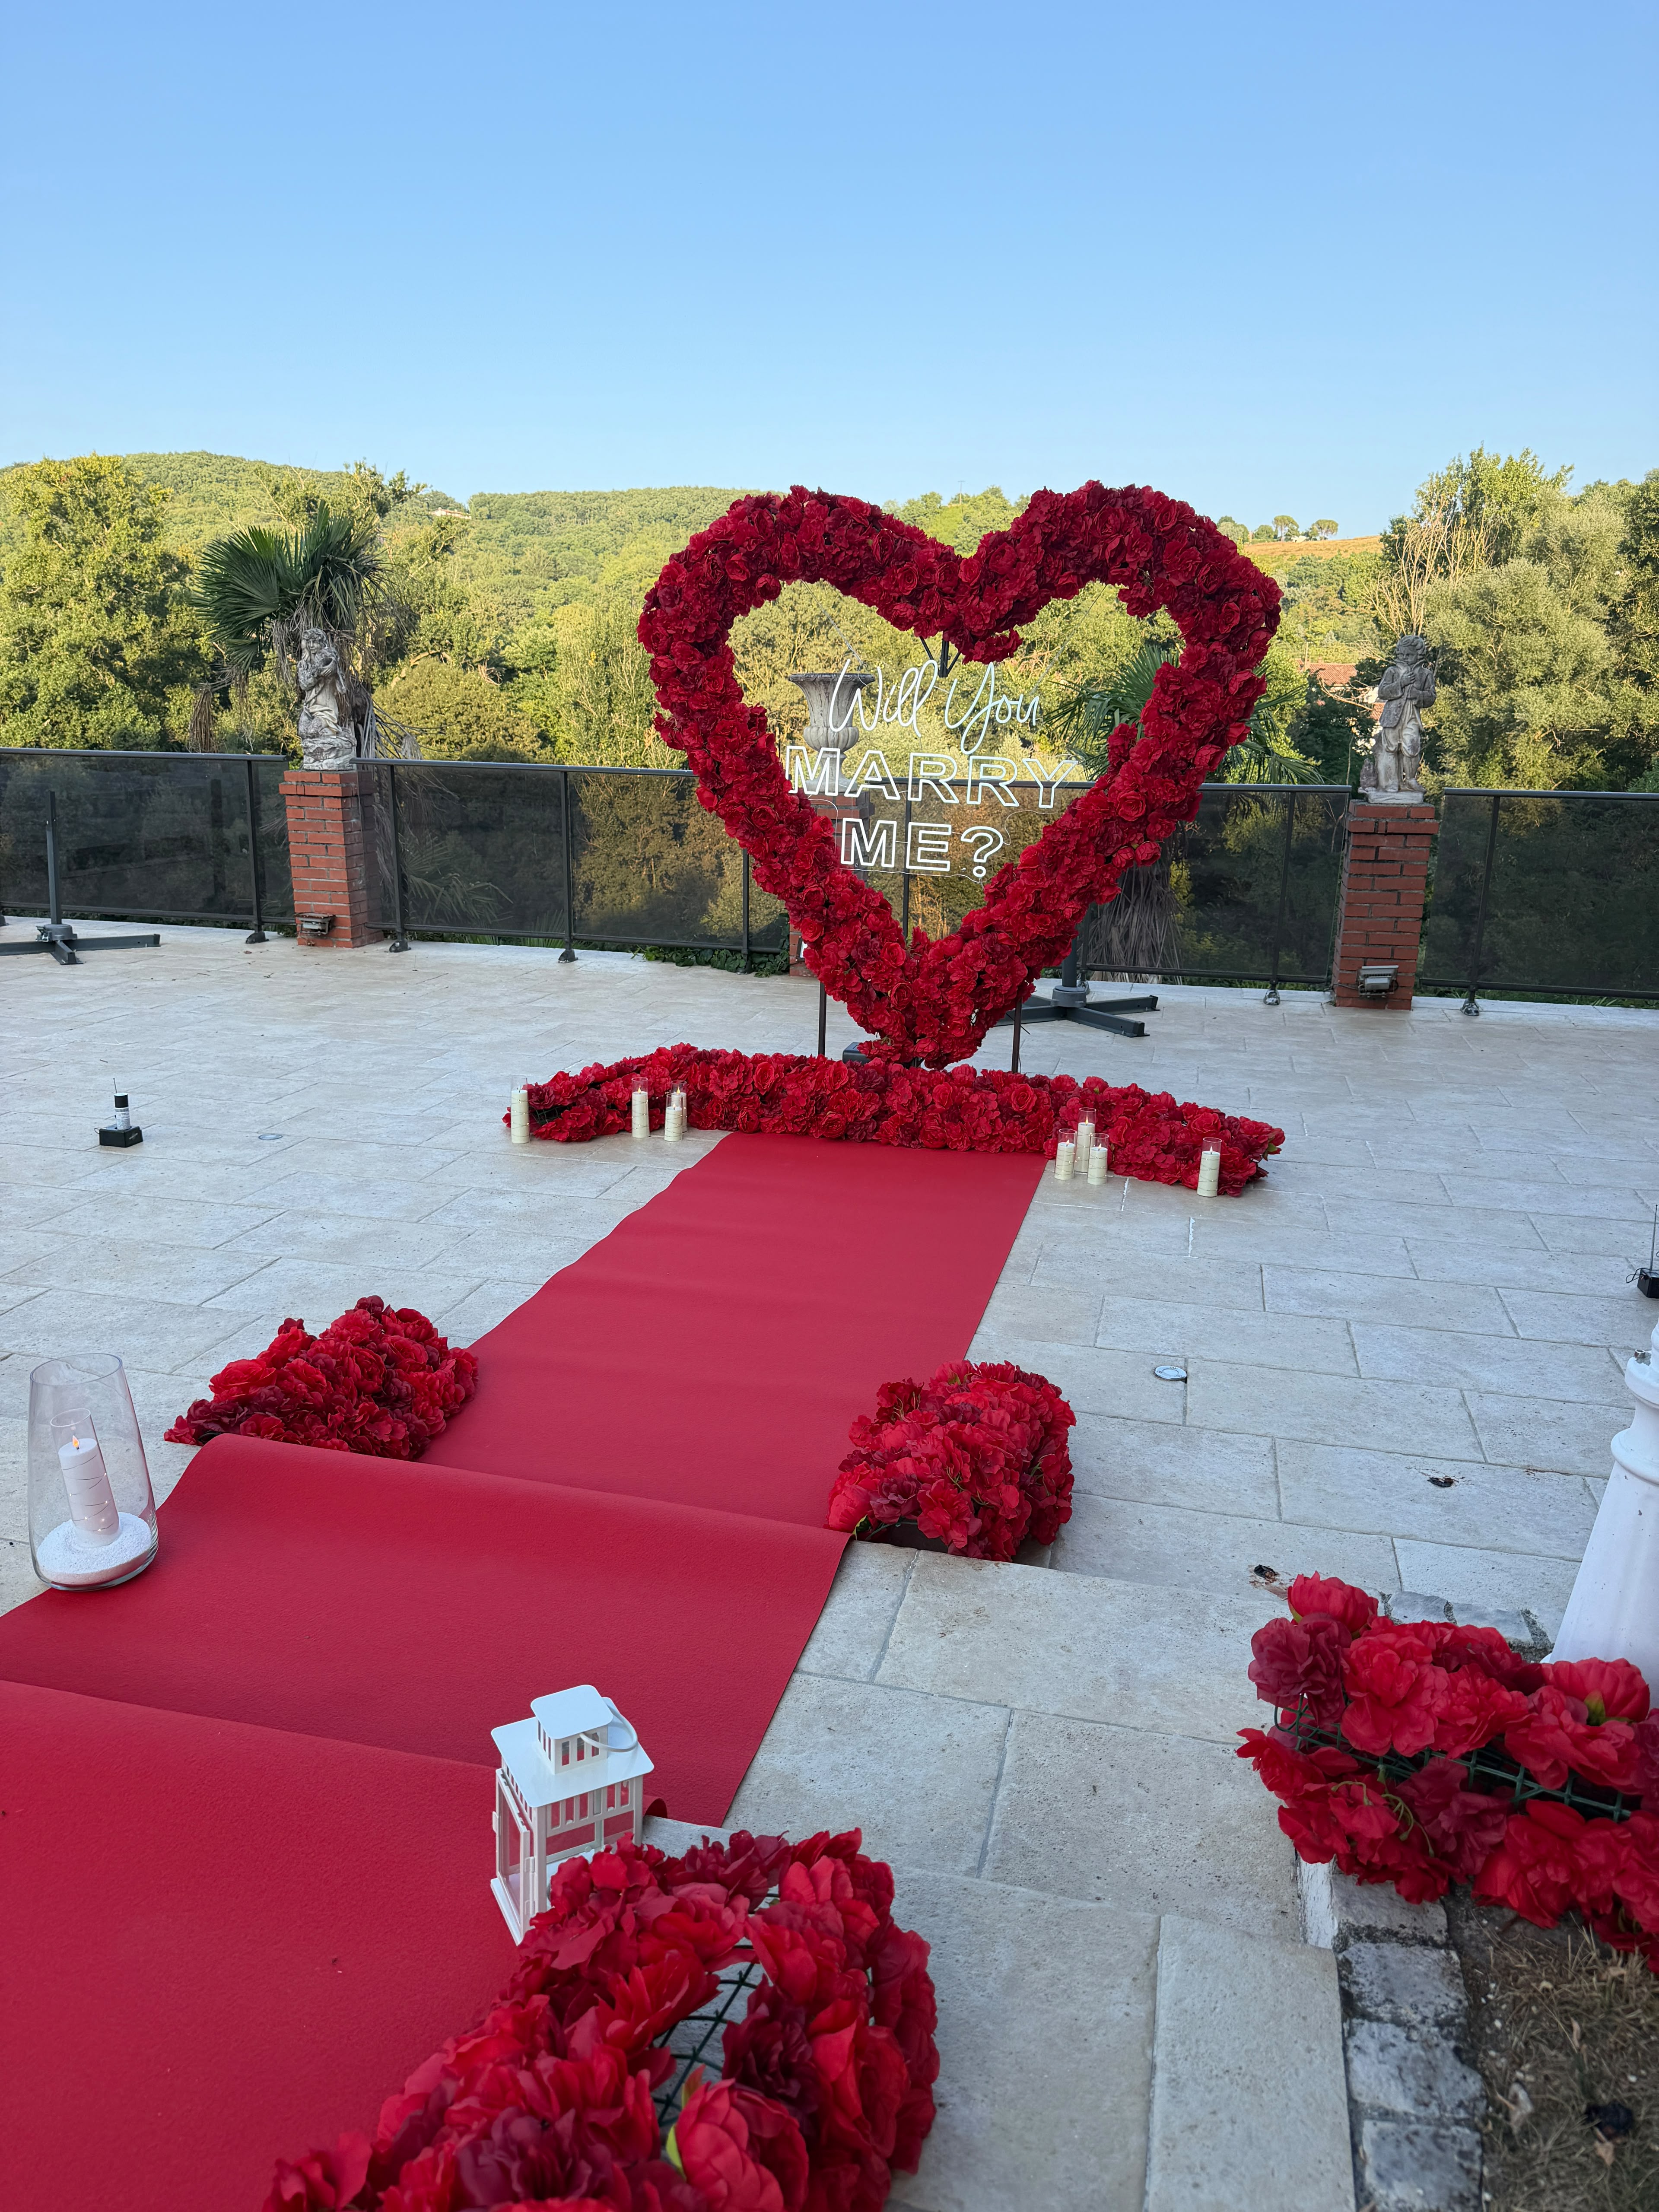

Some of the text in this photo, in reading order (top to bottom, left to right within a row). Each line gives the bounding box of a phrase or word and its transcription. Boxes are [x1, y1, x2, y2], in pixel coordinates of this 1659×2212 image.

[829, 659, 1039, 754] Will You
[785, 746, 1078, 808] MARRY
[841, 818, 1003, 877] ME?
